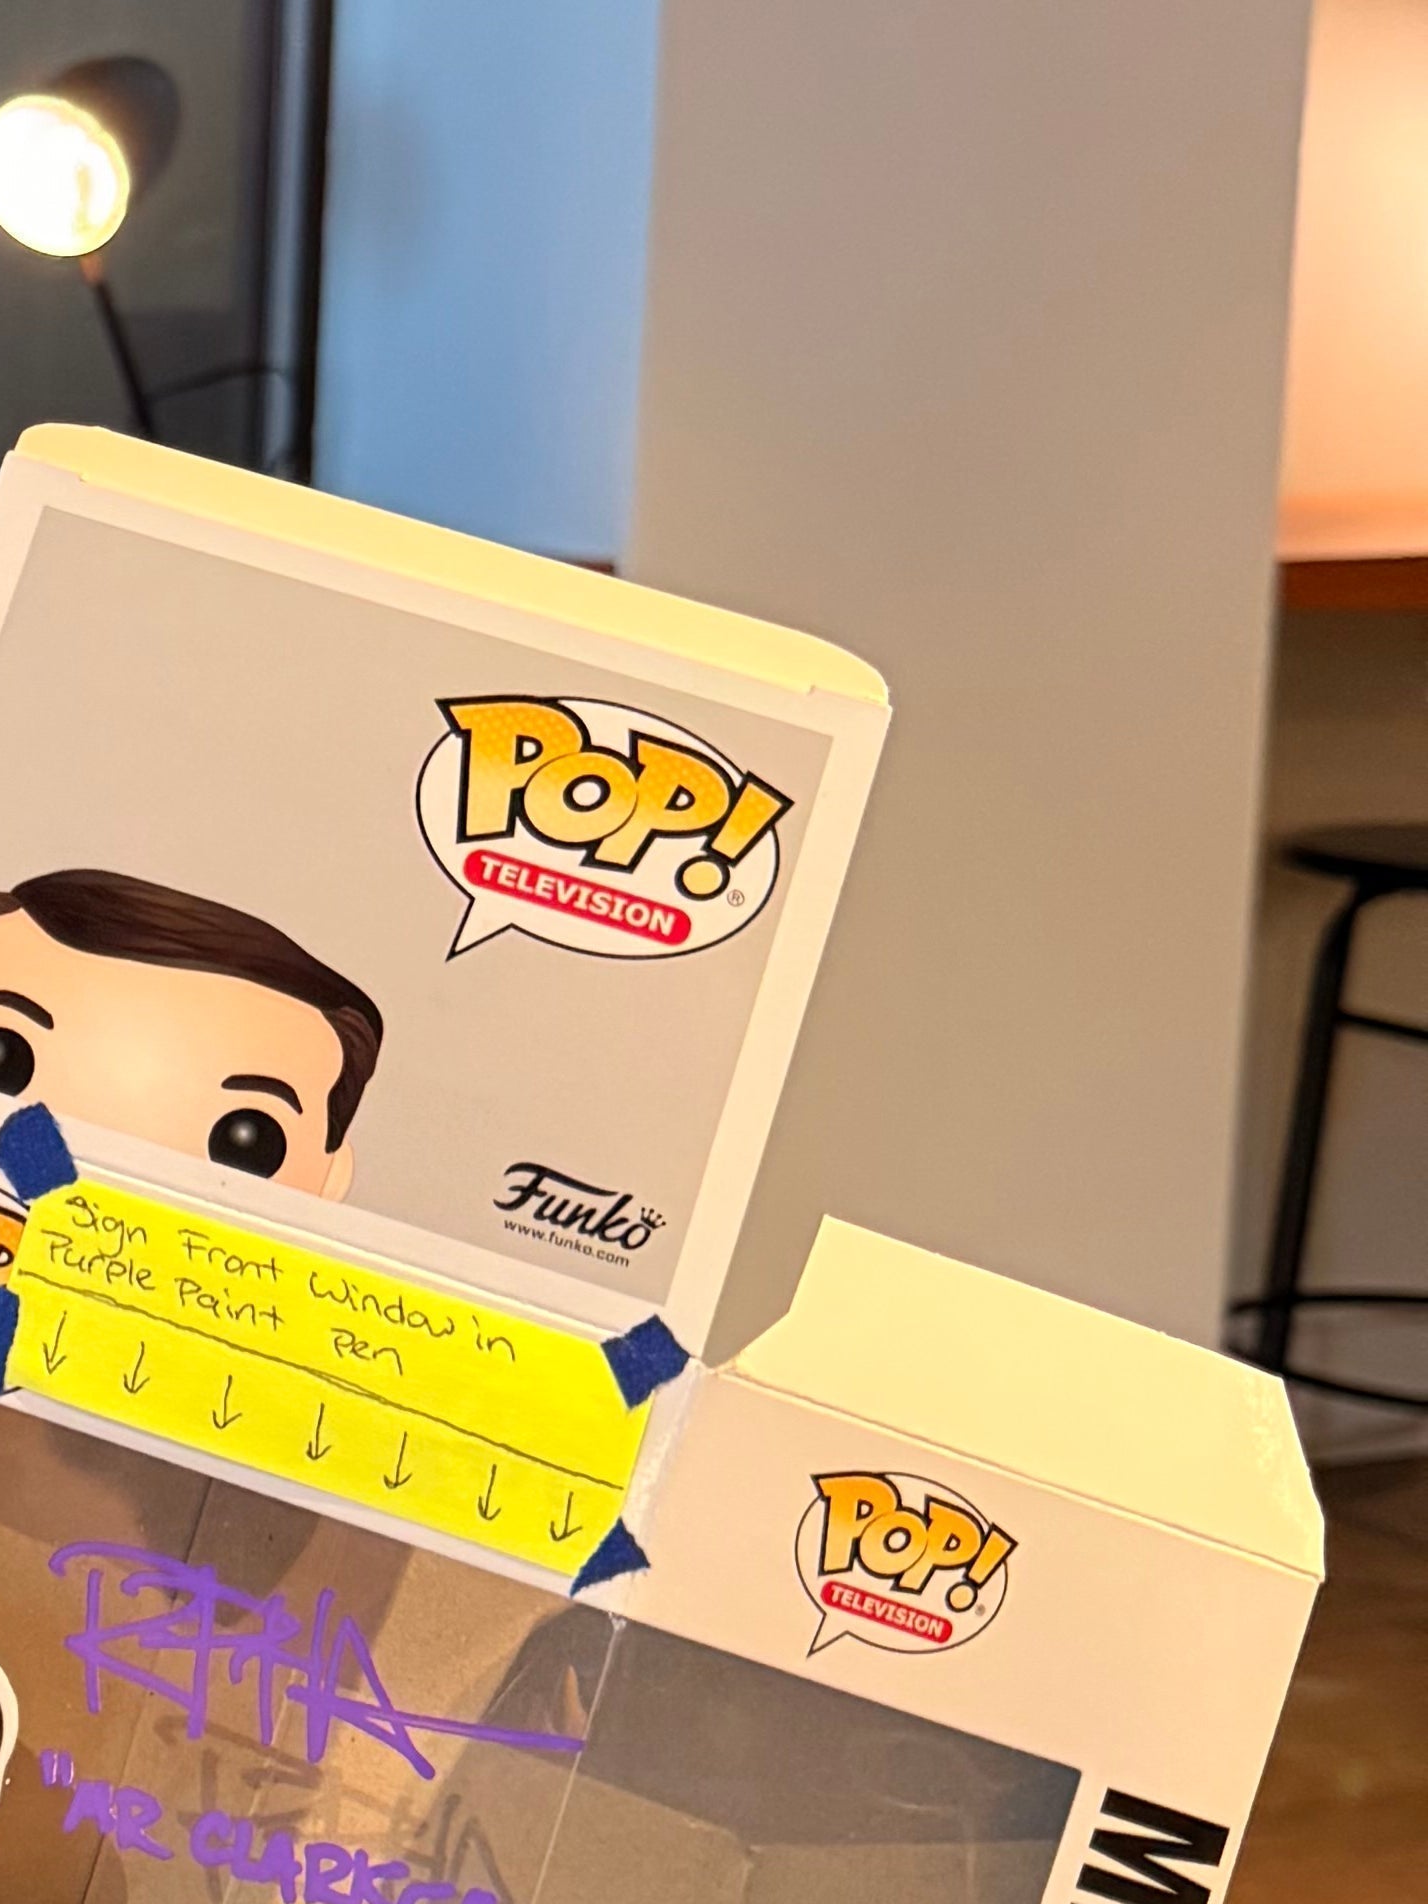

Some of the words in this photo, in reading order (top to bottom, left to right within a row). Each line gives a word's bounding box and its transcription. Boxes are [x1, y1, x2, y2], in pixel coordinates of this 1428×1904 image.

[436, 695, 794, 902] POP!
[470, 854, 681, 936] TELEVISION
[492, 1161, 656, 1251] Funko
[502, 1218, 630, 1268] www.funko.com
[39, 1227, 156, 1291] Purple
[174, 1276, 285, 1331] Paint
[64, 1194, 148, 1259] Sign
[176, 1227, 284, 1282] Front
[308, 1270, 456, 1338] Window
[470, 1314, 516, 1362] in
[809, 1470, 1019, 1615] POP!
[824, 1584, 949, 1638] TELEVISION
